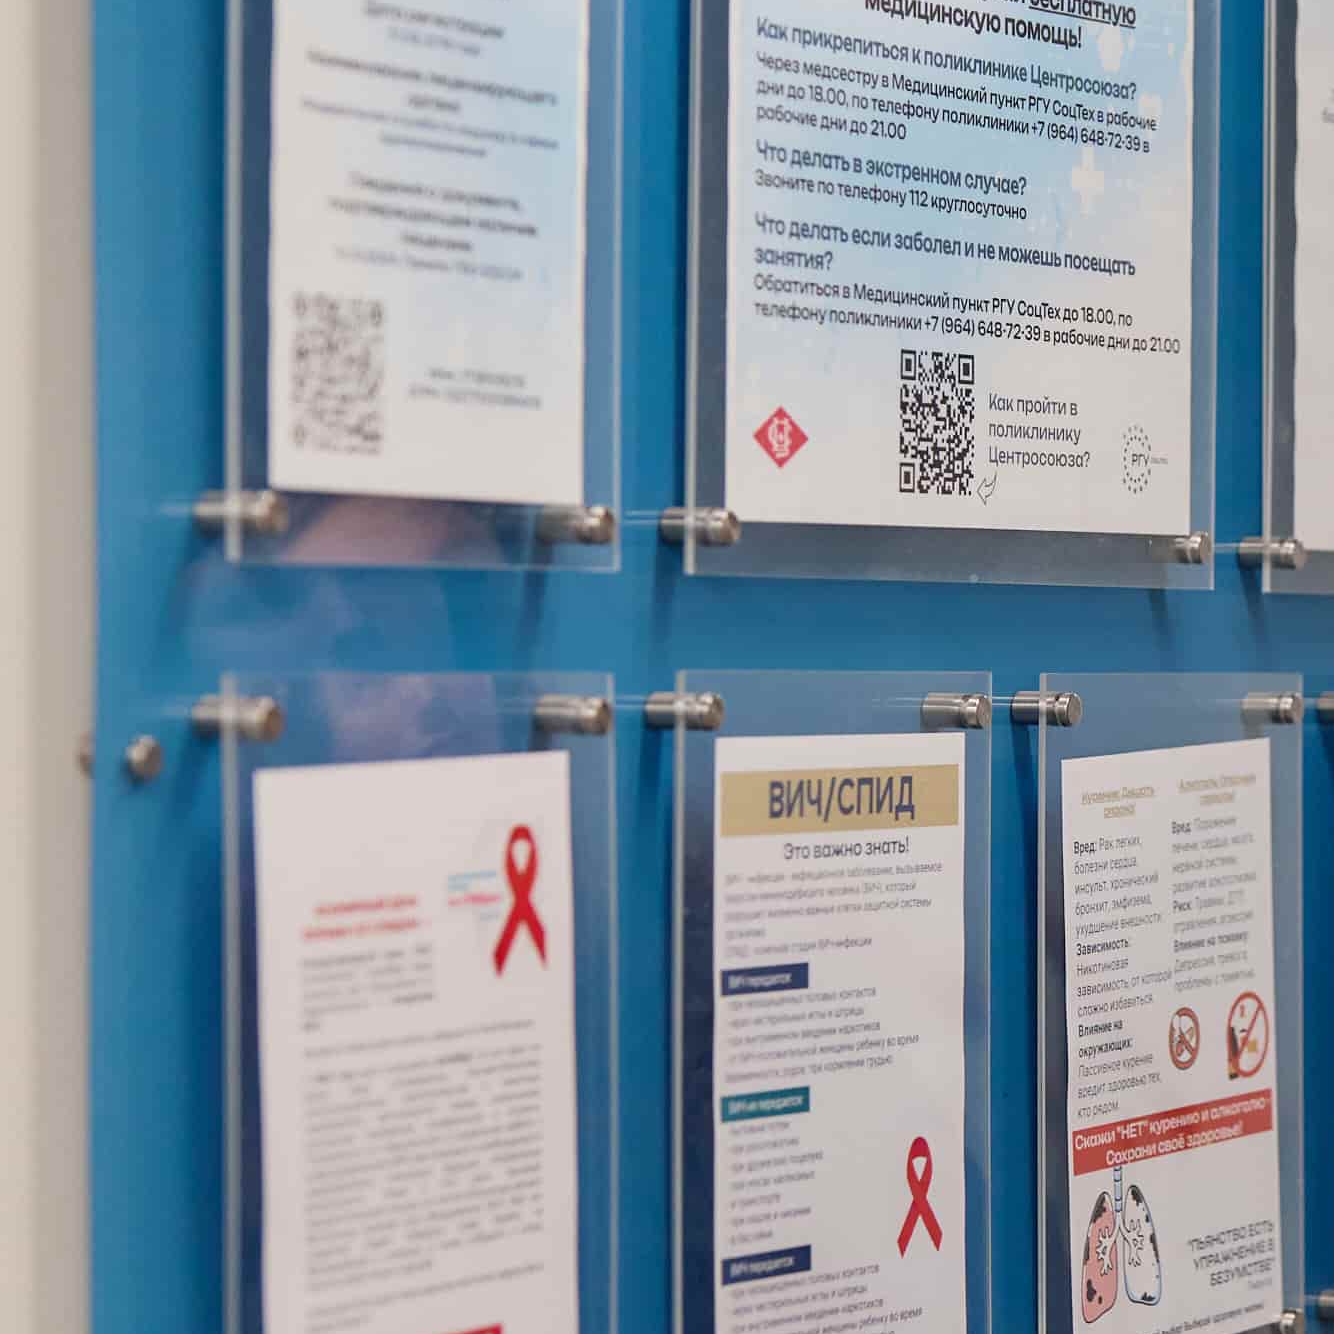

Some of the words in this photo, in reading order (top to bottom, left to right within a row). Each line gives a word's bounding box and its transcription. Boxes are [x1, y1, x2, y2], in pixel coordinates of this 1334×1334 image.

[1004, 14, 1082, 49] помощь!
[757, 17, 788, 41] Как
[792, 22, 909, 63] прикрепиться
[912, 49, 921, 65] к
[924, 49, 1027, 82] поликлинике
[1030, 61, 1137, 101] Центросоюза?
[757, 52, 800, 76] Через
[803, 61, 878, 88] медсестру
[881, 76, 889, 88] в
[892, 72, 987, 105] Медицинский
[989, 91, 1026, 111] пункт
[1028, 93, 1050, 113] РГУ
[1052, 98, 1093, 123] СоцТех
[1096, 110, 1104, 123] в
[1106, 107, 1157, 131] рабочие
[756, 81, 784, 98] дни
[787, 84, 806, 101] до
[809, 84, 848, 107] 18.00,
[851, 94, 868, 113] по
[871, 94, 939, 124] телефону
[942, 107, 1029, 135] поликлиники
[1031, 121, 1044, 137] +7
[1047, 123, 1078, 144] (964)
[1081, 127, 1140, 153] 648-72-39
[756, 105, 817, 131] рабочие
[820, 115, 846, 134] дни
[850, 119, 868, 137] до
[871, 119, 906, 141] 21.00
[757, 139, 787, 165] Что
[790, 145, 850, 172] делать
[853, 156, 862, 174] в
[866, 158, 961, 189] экстренном
[964, 170, 1027, 197] случае?
[756, 169, 814, 194] Звоните
[817, 179, 834, 197] по
[837, 179, 905, 208] телефону
[908, 189, 928, 207] 112
[931, 192, 1027, 221] круглосуточно
[755, 211, 785, 235] Что
[789, 219, 849, 245] делать
[852, 227, 891, 249] если
[895, 230, 961, 257] заболел
[965, 243, 974, 258] и
[977, 244, 996, 261] не
[999, 246, 1061, 269] можешь
[1064, 252, 1136, 278] посещать
[755, 246, 833, 273] занятия?
[754, 273, 839, 300] Обратиться
[842, 286, 850, 300] в
[853, 282, 949, 310] Медицинский
[952, 295, 989, 314] пункт
[992, 297, 1015, 315] РГУ
[1018, 300, 1061, 322] СоцТех
[1064, 307, 1079, 323] до
[1082, 306, 1117, 328] 18.00,
[1119, 312, 1132, 328] по
[755, 300, 826, 325] телефону
[829, 307, 922, 332] поликлиники
[924, 316, 938, 333] +7
[941, 315, 975, 337] (964)
[978, 319, 1040, 343] 648-72-39
[1053, 327, 1105, 349] рабочие
[1107, 335, 1129, 352] дни
[1132, 337, 1147, 353] до
[1150, 336, 1180, 355] 21.00
[989, 393, 1013, 413] Как
[1017, 396, 1066, 419] пройти
[1070, 401, 1077, 416] в
[988, 421, 1081, 445] поликлинику
[988, 447, 1090, 469] Центросоюза?
[769, 775, 915, 822] ВИЧ/СПИД
[784, 842, 810, 860] Это
[814, 840, 863, 859] важно
[865, 836, 910, 856] знать!
[1074, 841, 1096, 856] Вред:
[1099, 837, 1114, 851] Рак
[1074, 860, 1108, 875] болезни
[1077, 958, 1129, 977] Никотиновая
[1077, 1000, 1109, 1017] сложно
[1079, 1022, 1112, 1037] Влияние
[1114, 1020, 1123, 1030] на
[1075, 1129, 1115, 1150] Скажи
[1149, 1111, 1200, 1136] курению
[1201, 1109, 1209, 1120] и
[1106, 1145, 1157, 1165] Сохрани
